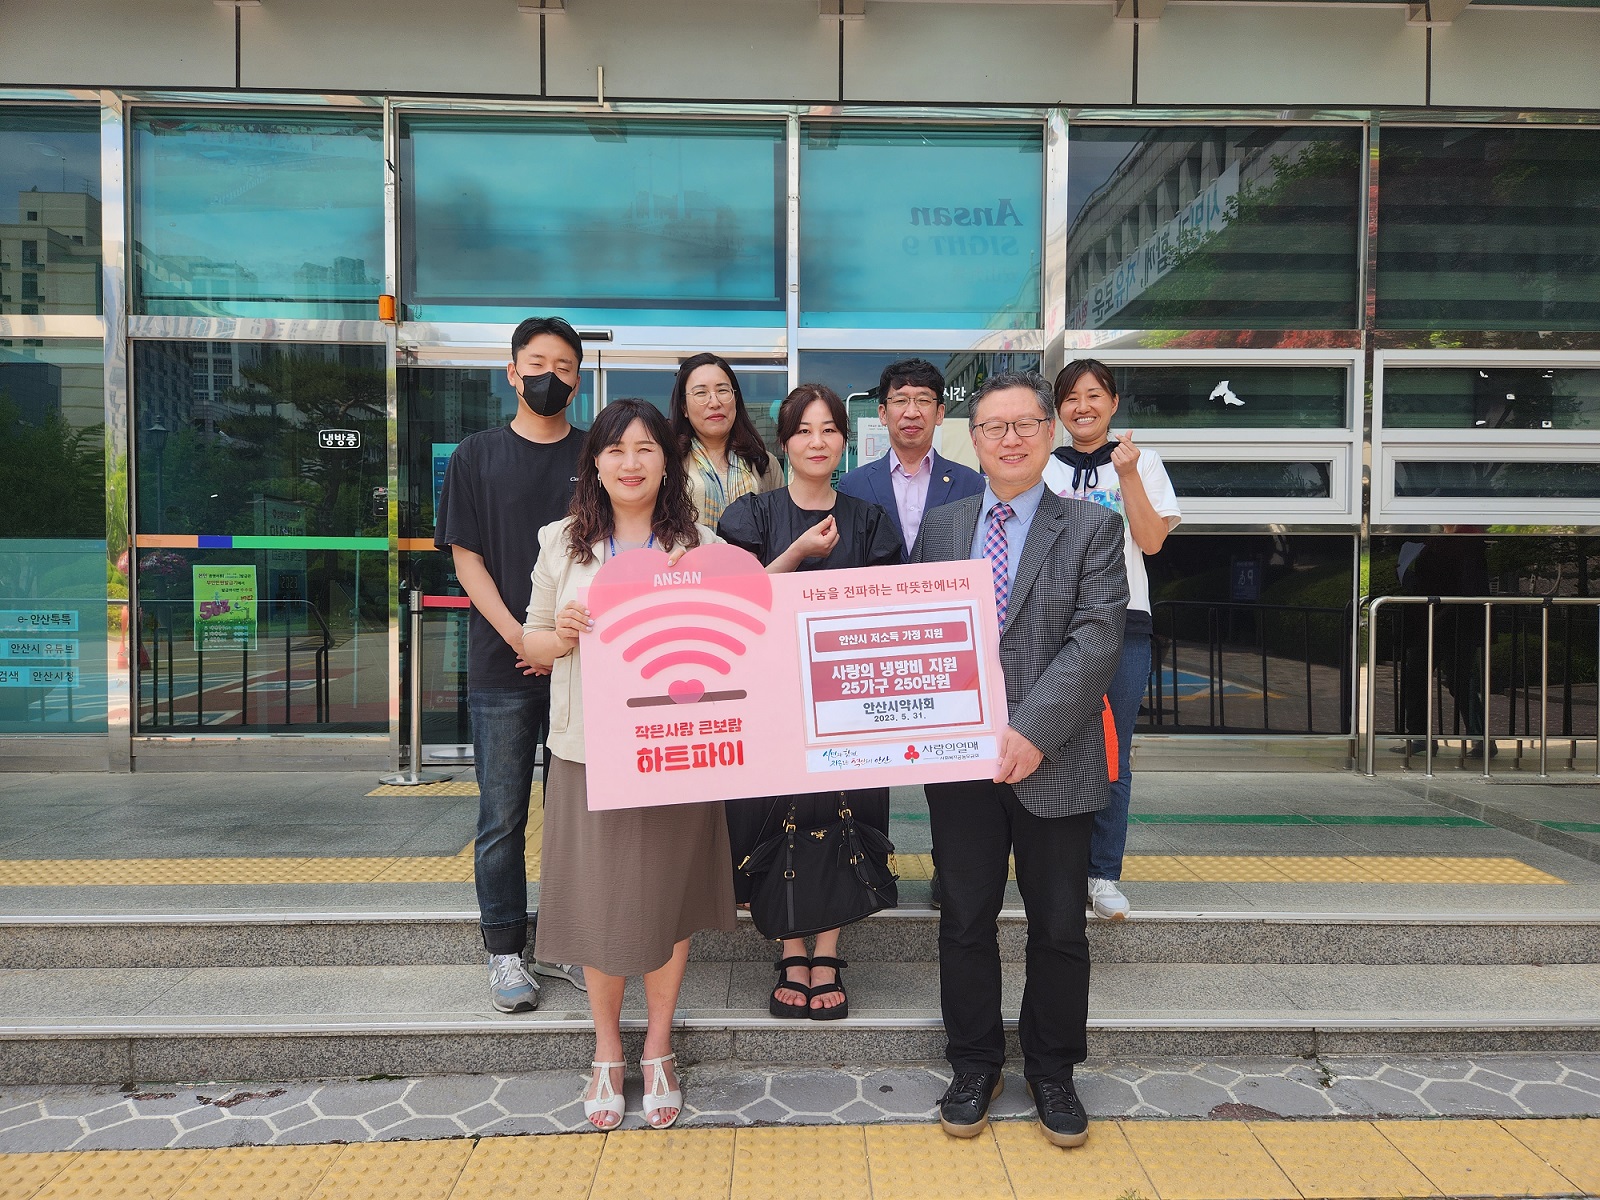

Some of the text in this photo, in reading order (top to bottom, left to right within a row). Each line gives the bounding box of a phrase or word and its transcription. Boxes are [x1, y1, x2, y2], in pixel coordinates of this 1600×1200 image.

[322, 433, 357, 446] 냉방중
[653, 571, 702, 587] ANSAN
[803, 577, 970, 602] 나눔을 전파하는 따뜻한에너지
[838, 628, 943, 646] 안산시 저소득 가정 지원
[11, 643, 74, 654] 안산시 유튜브
[832, 656, 958, 680] 사랑의 냉방비 지원
[841, 673, 951, 695] 25가구 250만원
[863, 697, 935, 715] 안산시약사회
[874, 713, 898, 722] 2023.
[635, 717, 742, 740] 작은사랑 큰보람
[636, 739, 744, 773] 하트파이
[922, 741, 979, 756] 사랑의열매
